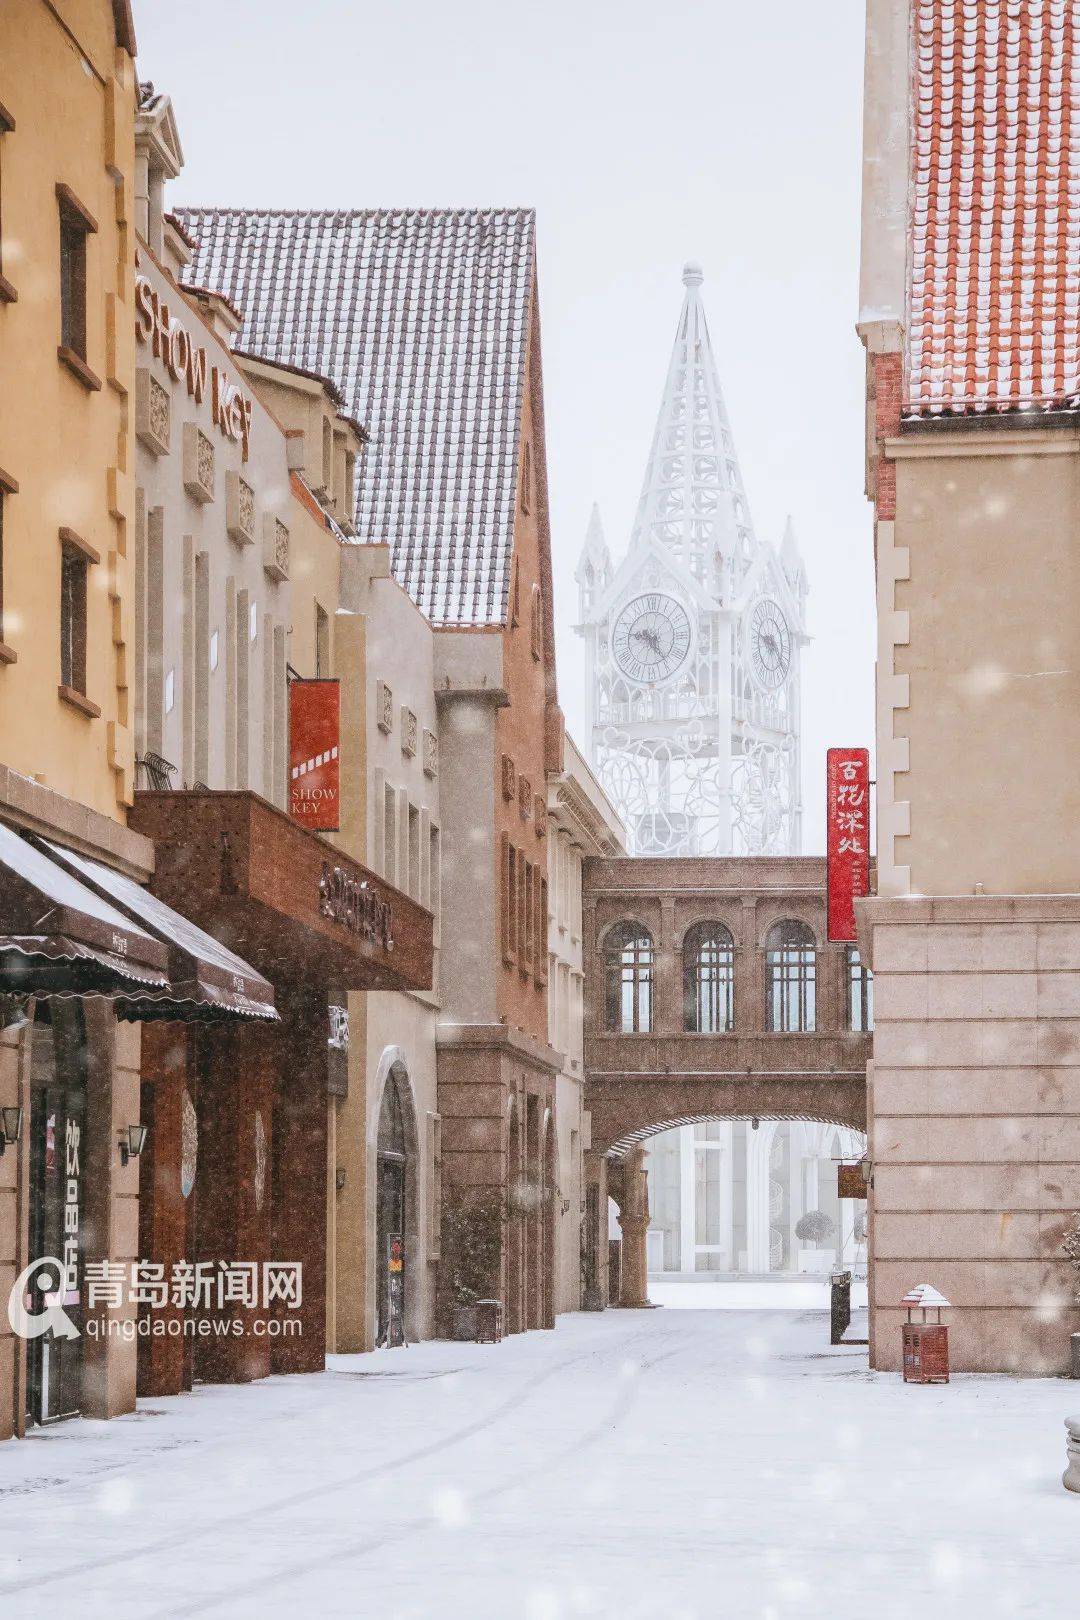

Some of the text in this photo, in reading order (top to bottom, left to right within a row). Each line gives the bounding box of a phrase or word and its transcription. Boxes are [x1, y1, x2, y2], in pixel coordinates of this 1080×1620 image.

[135, 275, 206, 404] SHOW
[292, 788, 337, 800] SHOW
[292, 802, 321, 814] KEY
[837, 760, 865, 854] 百花深处
